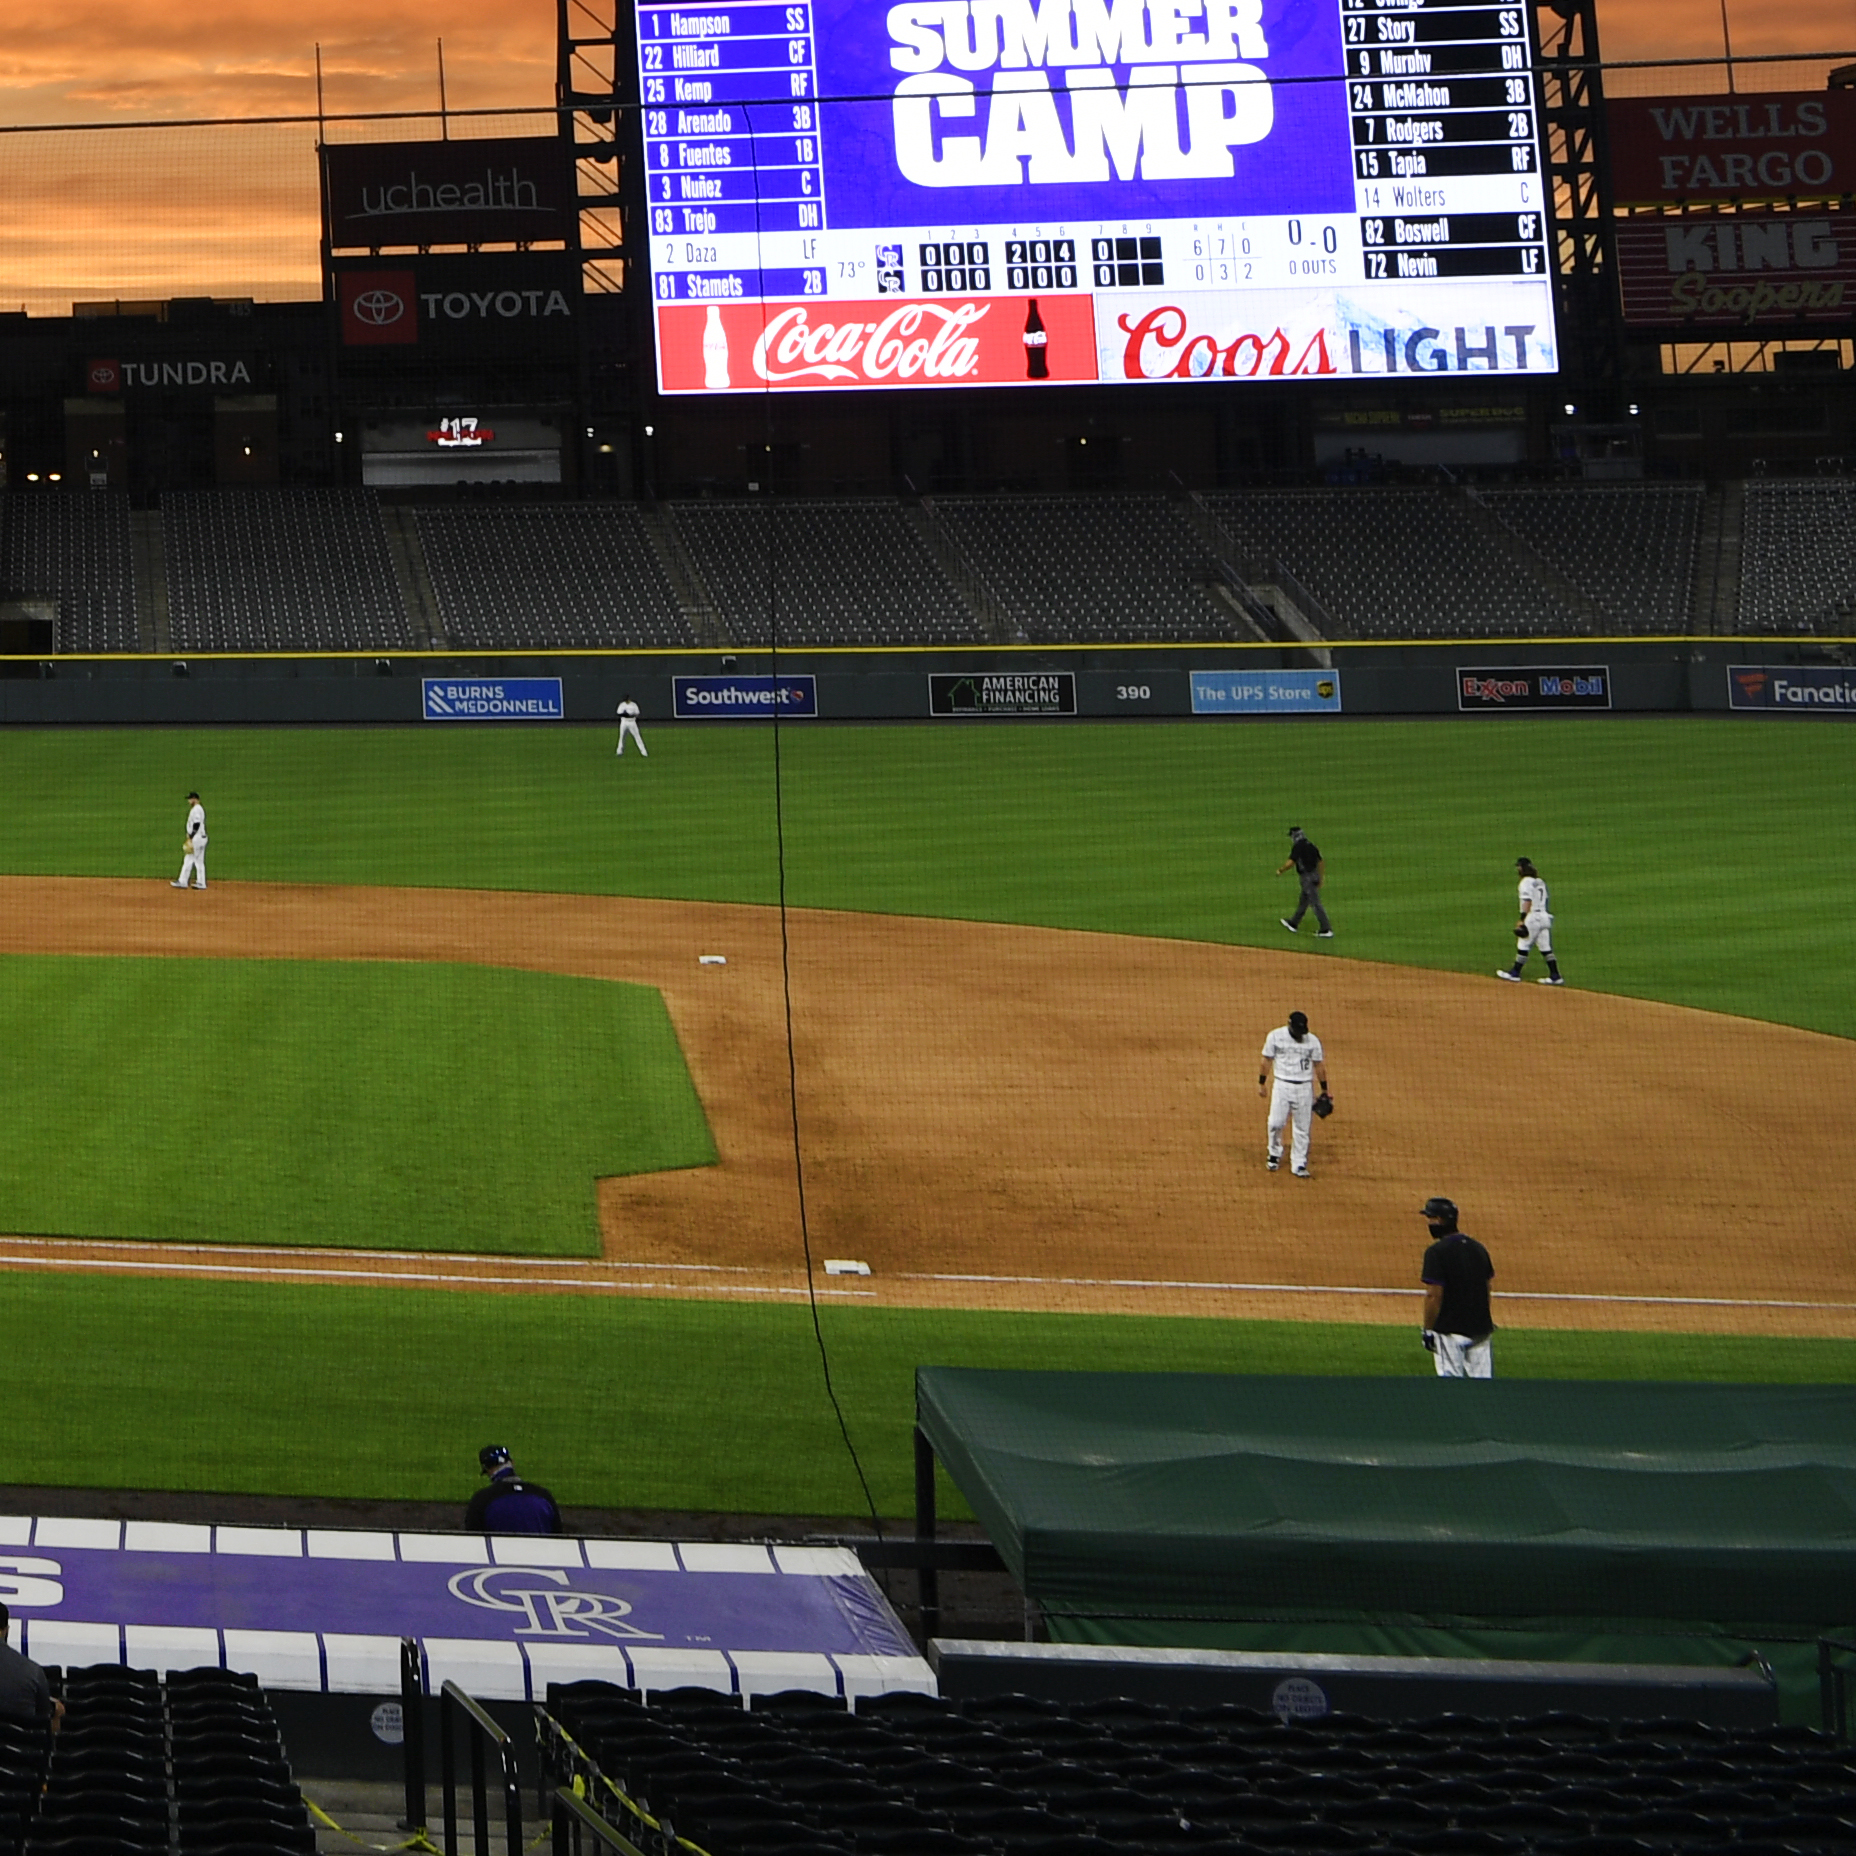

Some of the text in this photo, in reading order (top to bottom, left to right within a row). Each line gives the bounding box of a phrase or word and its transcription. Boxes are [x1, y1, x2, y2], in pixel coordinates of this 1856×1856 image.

[652, 7, 805, 39] 1 Hampson SS
[1348, 11, 1519, 44] 27 Story SS
[644, 40, 806, 70] 22 Hilliard CF
[1360, 51, 1370, 76] 9
[1502, 45, 1523, 70] DH
[646, 73, 808, 104] 25 Kemp RF
[1354, 79, 1526, 110] 24 McMahon 3B
[649, 105, 811, 135] 28 Arenado 3B
[892, 62, 1274, 188] CAMP
[1366, 112, 1529, 144] 7 Rodgers 2B
[1649, 100, 1828, 141] WELLS
[660, 138, 814, 168] 8 Fuentes 1B
[1360, 146, 1530, 178] 15 Tapia RF
[1659, 149, 1833, 190] FARGO
[362, 167, 538, 212] uchealth
[662, 170, 812, 200] 3 Nuñez C
[1364, 182, 1530, 209] 14 Wolters C
[655, 204, 818, 235] 83 Trejo DH
[1365, 214, 1536, 244] 82 Boswell CF
[666, 238, 818, 264] 2 Daza LF
[1664, 220, 1839, 272] KING
[1303, 259, 1337, 274] OUTS
[1368, 249, 1539, 278] 72 Nevin LF
[659, 270, 822, 299] 81 Stamets 2B
[1668, 272, 1845, 326] Soopers
[421, 290, 571, 320] TOYOTA
[752, 302, 991, 381] Coca-Cola
[1118, 305, 1536, 379] Coors LIGHT
[121, 361, 251, 387] TUNDRA
[447, 685, 505, 700] BURNS
[685, 686, 790, 705] Southwest
[982, 676, 1059, 690] AMERICAN
[982, 690, 1060, 704] FINANCING
[1116, 685, 1151, 700] 390
[1196, 687, 1226, 701] The
[1232, 686, 1264, 700] UPS
[1269, 685, 1311, 700] Store
[1463, 676, 1603, 702] Exxon Mobil
